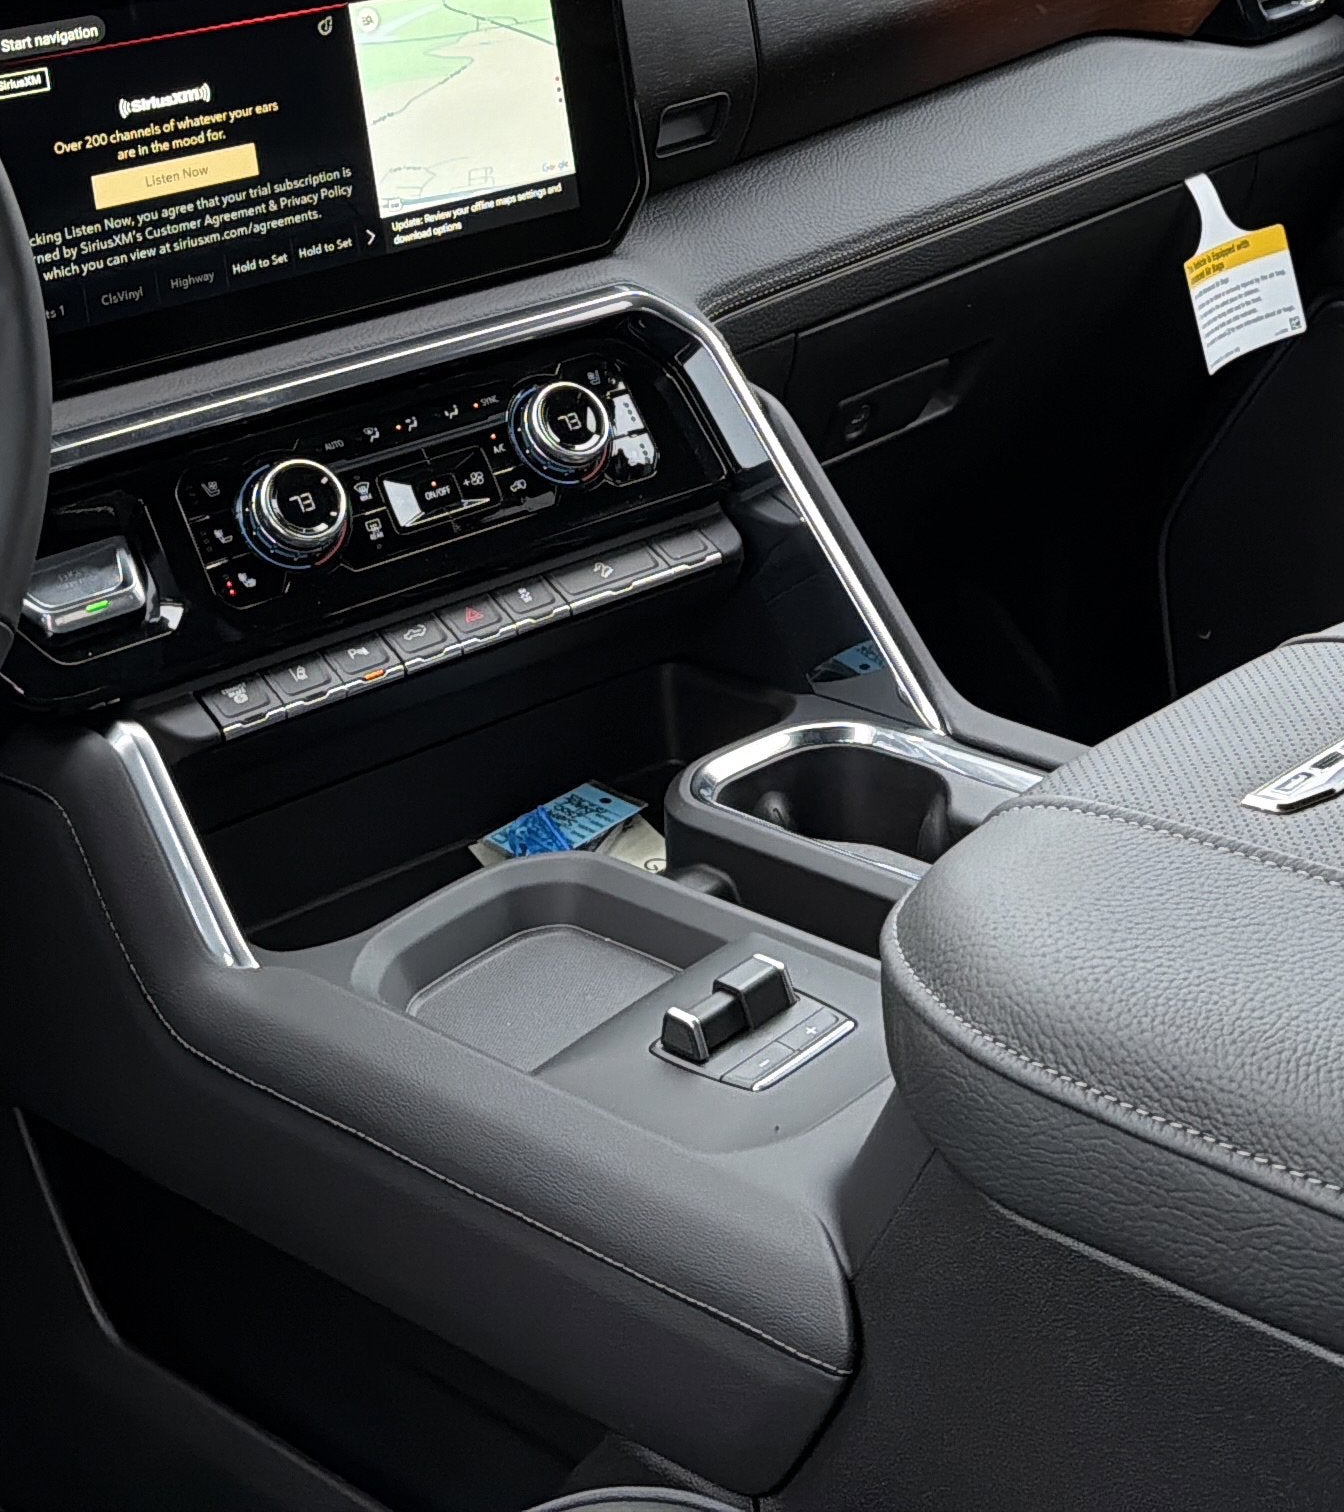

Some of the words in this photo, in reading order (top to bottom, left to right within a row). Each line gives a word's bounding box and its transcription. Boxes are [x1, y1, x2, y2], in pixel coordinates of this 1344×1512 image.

[0, 37, 33, 53] Start
[34, 24, 99, 48] navigation
[54, 139, 83, 155] Over
[84, 133, 108, 150] 200
[109, 123, 161, 144] channels
[162, 119, 176, 132] of
[177, 109, 228, 130] whatever
[228, 106, 254, 124] your
[255, 101, 279, 114] ears
[117, 147, 137, 161] are
[138, 144, 150, 157] in
[151, 140, 170, 154] the
[171, 132, 206, 149] mood
[206, 128, 227, 141] for.
[144, 171, 180, 188] Listen
[182, 166, 209, 183] Now
[28, 229, 63, 247] cking
[64, 222, 103, 240] Listen
[104, 216, 136, 231] Now,
[137, 211, 159, 227] you
[161, 203, 195, 219] agree
[196, 196, 220, 210] that
[220, 190, 247, 208] your
[248, 182, 272, 199] trial
[273, 169, 341, 193] subscription
[342, 166, 353, 178] is
[391, 216, 423, 232] Update:
[424, 208, 453, 223] Review
[452, 205, 470, 219] your
[470, 199, 495, 213] offline
[495, 194, 517, 208] maps
[517, 187, 547, 201] settings
[547, 182, 563, 196] and
[62, 244, 78, 261] by
[80, 230, 143, 254] SiriusXM's
[145, 218, 202, 240] Customer
[204, 202, 267, 228] Agreement
[268, 199, 279, 212] &
[279, 191, 319, 210] Privacy
[320, 184, 354, 200] Policy
[393, 226, 433, 245] download
[433, 220, 463, 237] options
[42, 263, 80, 282] which
[81, 260, 104, 276] you
[106, 253, 129, 267] can
[129, 248, 157, 263] view
[158, 242, 172, 255] at
[173, 208, 323, 252] siriusxm.com/agreements.
[298, 244, 323, 259] Hold
[323, 242, 335, 253] to
[336, 237, 353, 250] Set
[232, 259, 257, 275] Hold
[258, 256, 270, 268] to
[271, 252, 289, 267] Set
[170, 270, 215, 290] Highway
[557, 412, 582, 431] 73
[324, 439, 345, 451] AUTO
[289, 491, 316, 513] 73
[424, 485, 451, 501] ON/OFF
